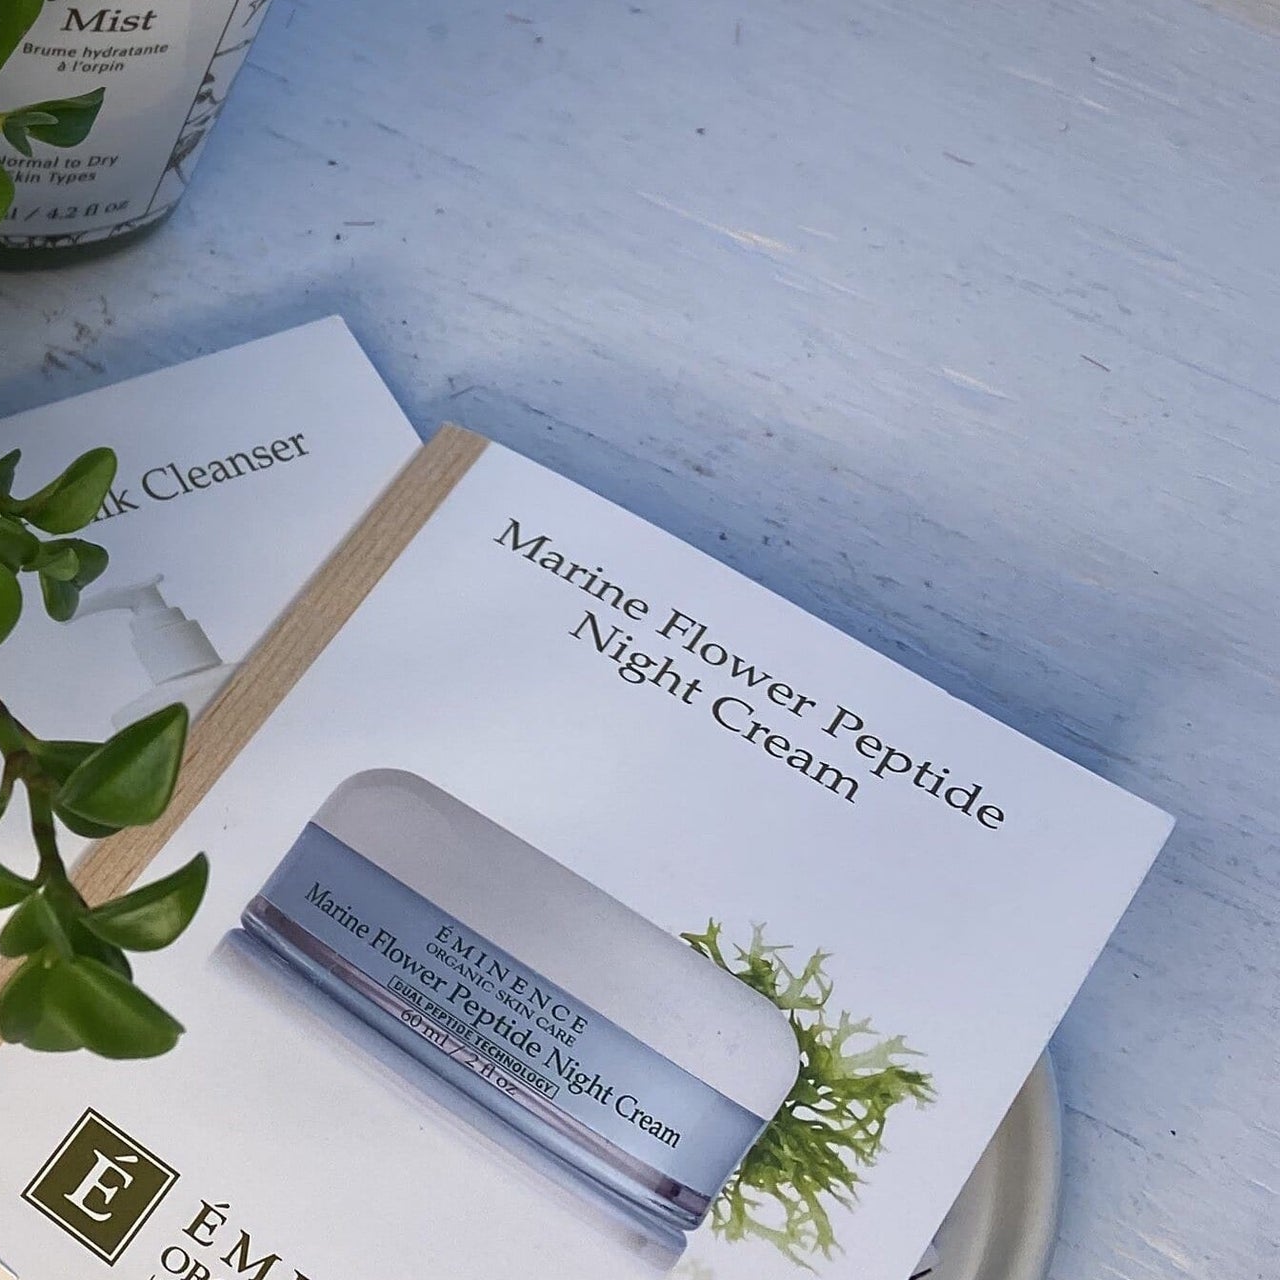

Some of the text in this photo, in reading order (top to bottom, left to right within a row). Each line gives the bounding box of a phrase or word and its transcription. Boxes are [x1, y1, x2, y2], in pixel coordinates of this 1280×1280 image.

[23, 42, 169, 59] Brume hydratante
[59, 7, 157, 32] Mist
[14, 171, 97, 185] kin Types
[65, 157, 82, 168] to
[87, 155, 119, 169] Dry
[142, 433, 310, 501] Cleanser
[493, 517, 1008, 832] Marine Flower Peptide
[568, 610, 862, 805] Night Cream
[304, 882, 682, 1149] Marine Flower Peptide Night Cream
[426, 942, 577, 1048] ORGANIC SKIN CARE
[434, 924, 588, 1035] ÉMINENCE
[393, 979, 553, 1093] DUAL PEPTIDE TECHNOLOGY
[400, 1008, 423, 1028] 60
[422, 1023, 449, 1048] ml
[464, 1054, 479, 1069] 2
[478, 1062, 496, 1079] fl
[496, 1076, 519, 1096] oz
[64, 1149, 138, 1222] É
